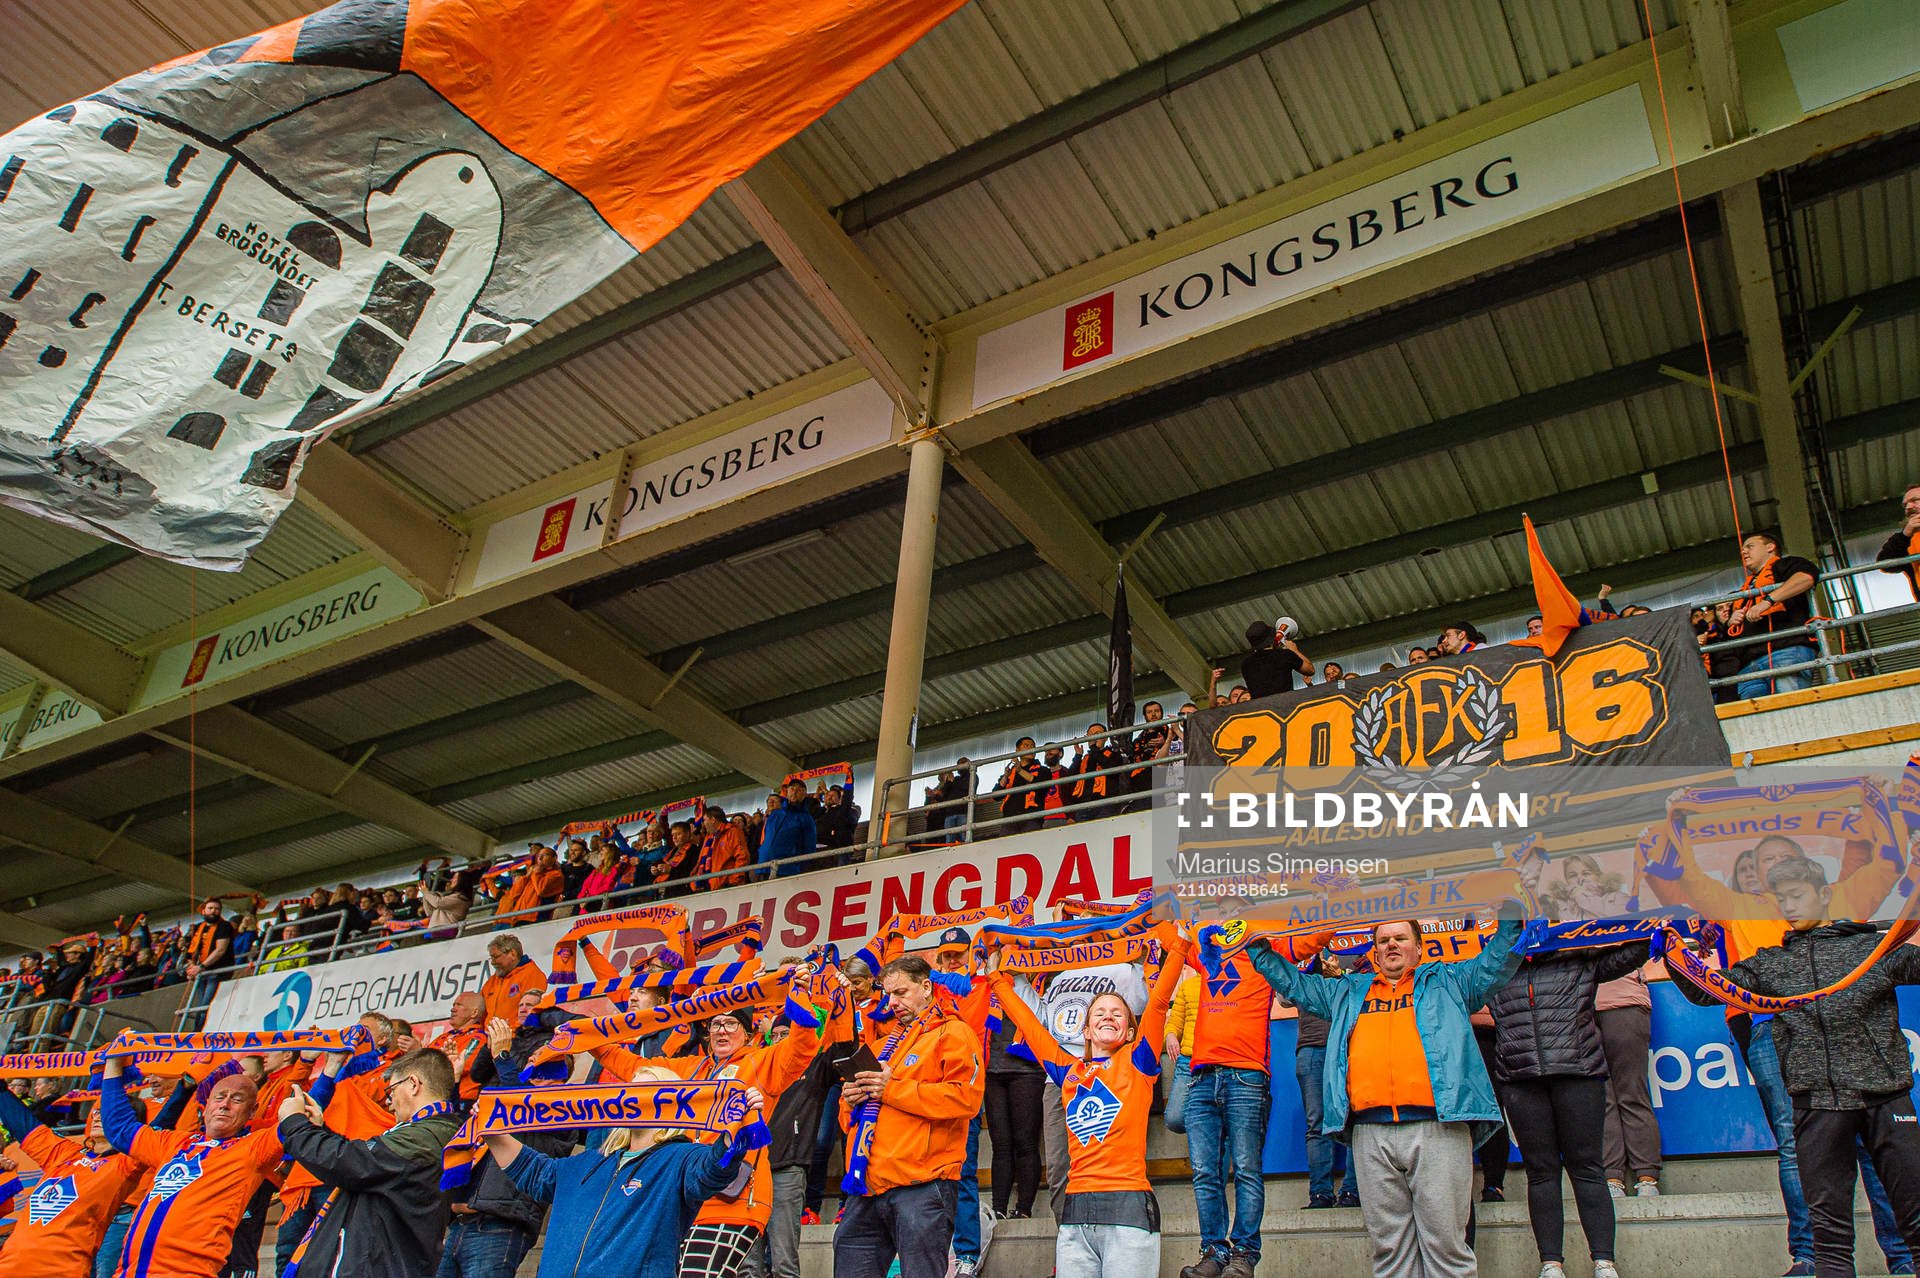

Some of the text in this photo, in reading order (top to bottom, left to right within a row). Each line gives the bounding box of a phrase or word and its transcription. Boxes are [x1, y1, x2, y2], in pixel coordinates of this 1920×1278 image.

[245, 221, 301, 267] HOTEL
[1138, 155, 1520, 328] KONGSBERG
[218, 582, 382, 665] KONGSBERG
[1287, 879, 1466, 926] Aalesunds FK
[1558, 919, 1629, 940] Since
[1005, 942, 1115, 967] AALESUNDS
[653, 979, 765, 1024] Stormen
[485, 1087, 701, 1129] Aalesunds FK
